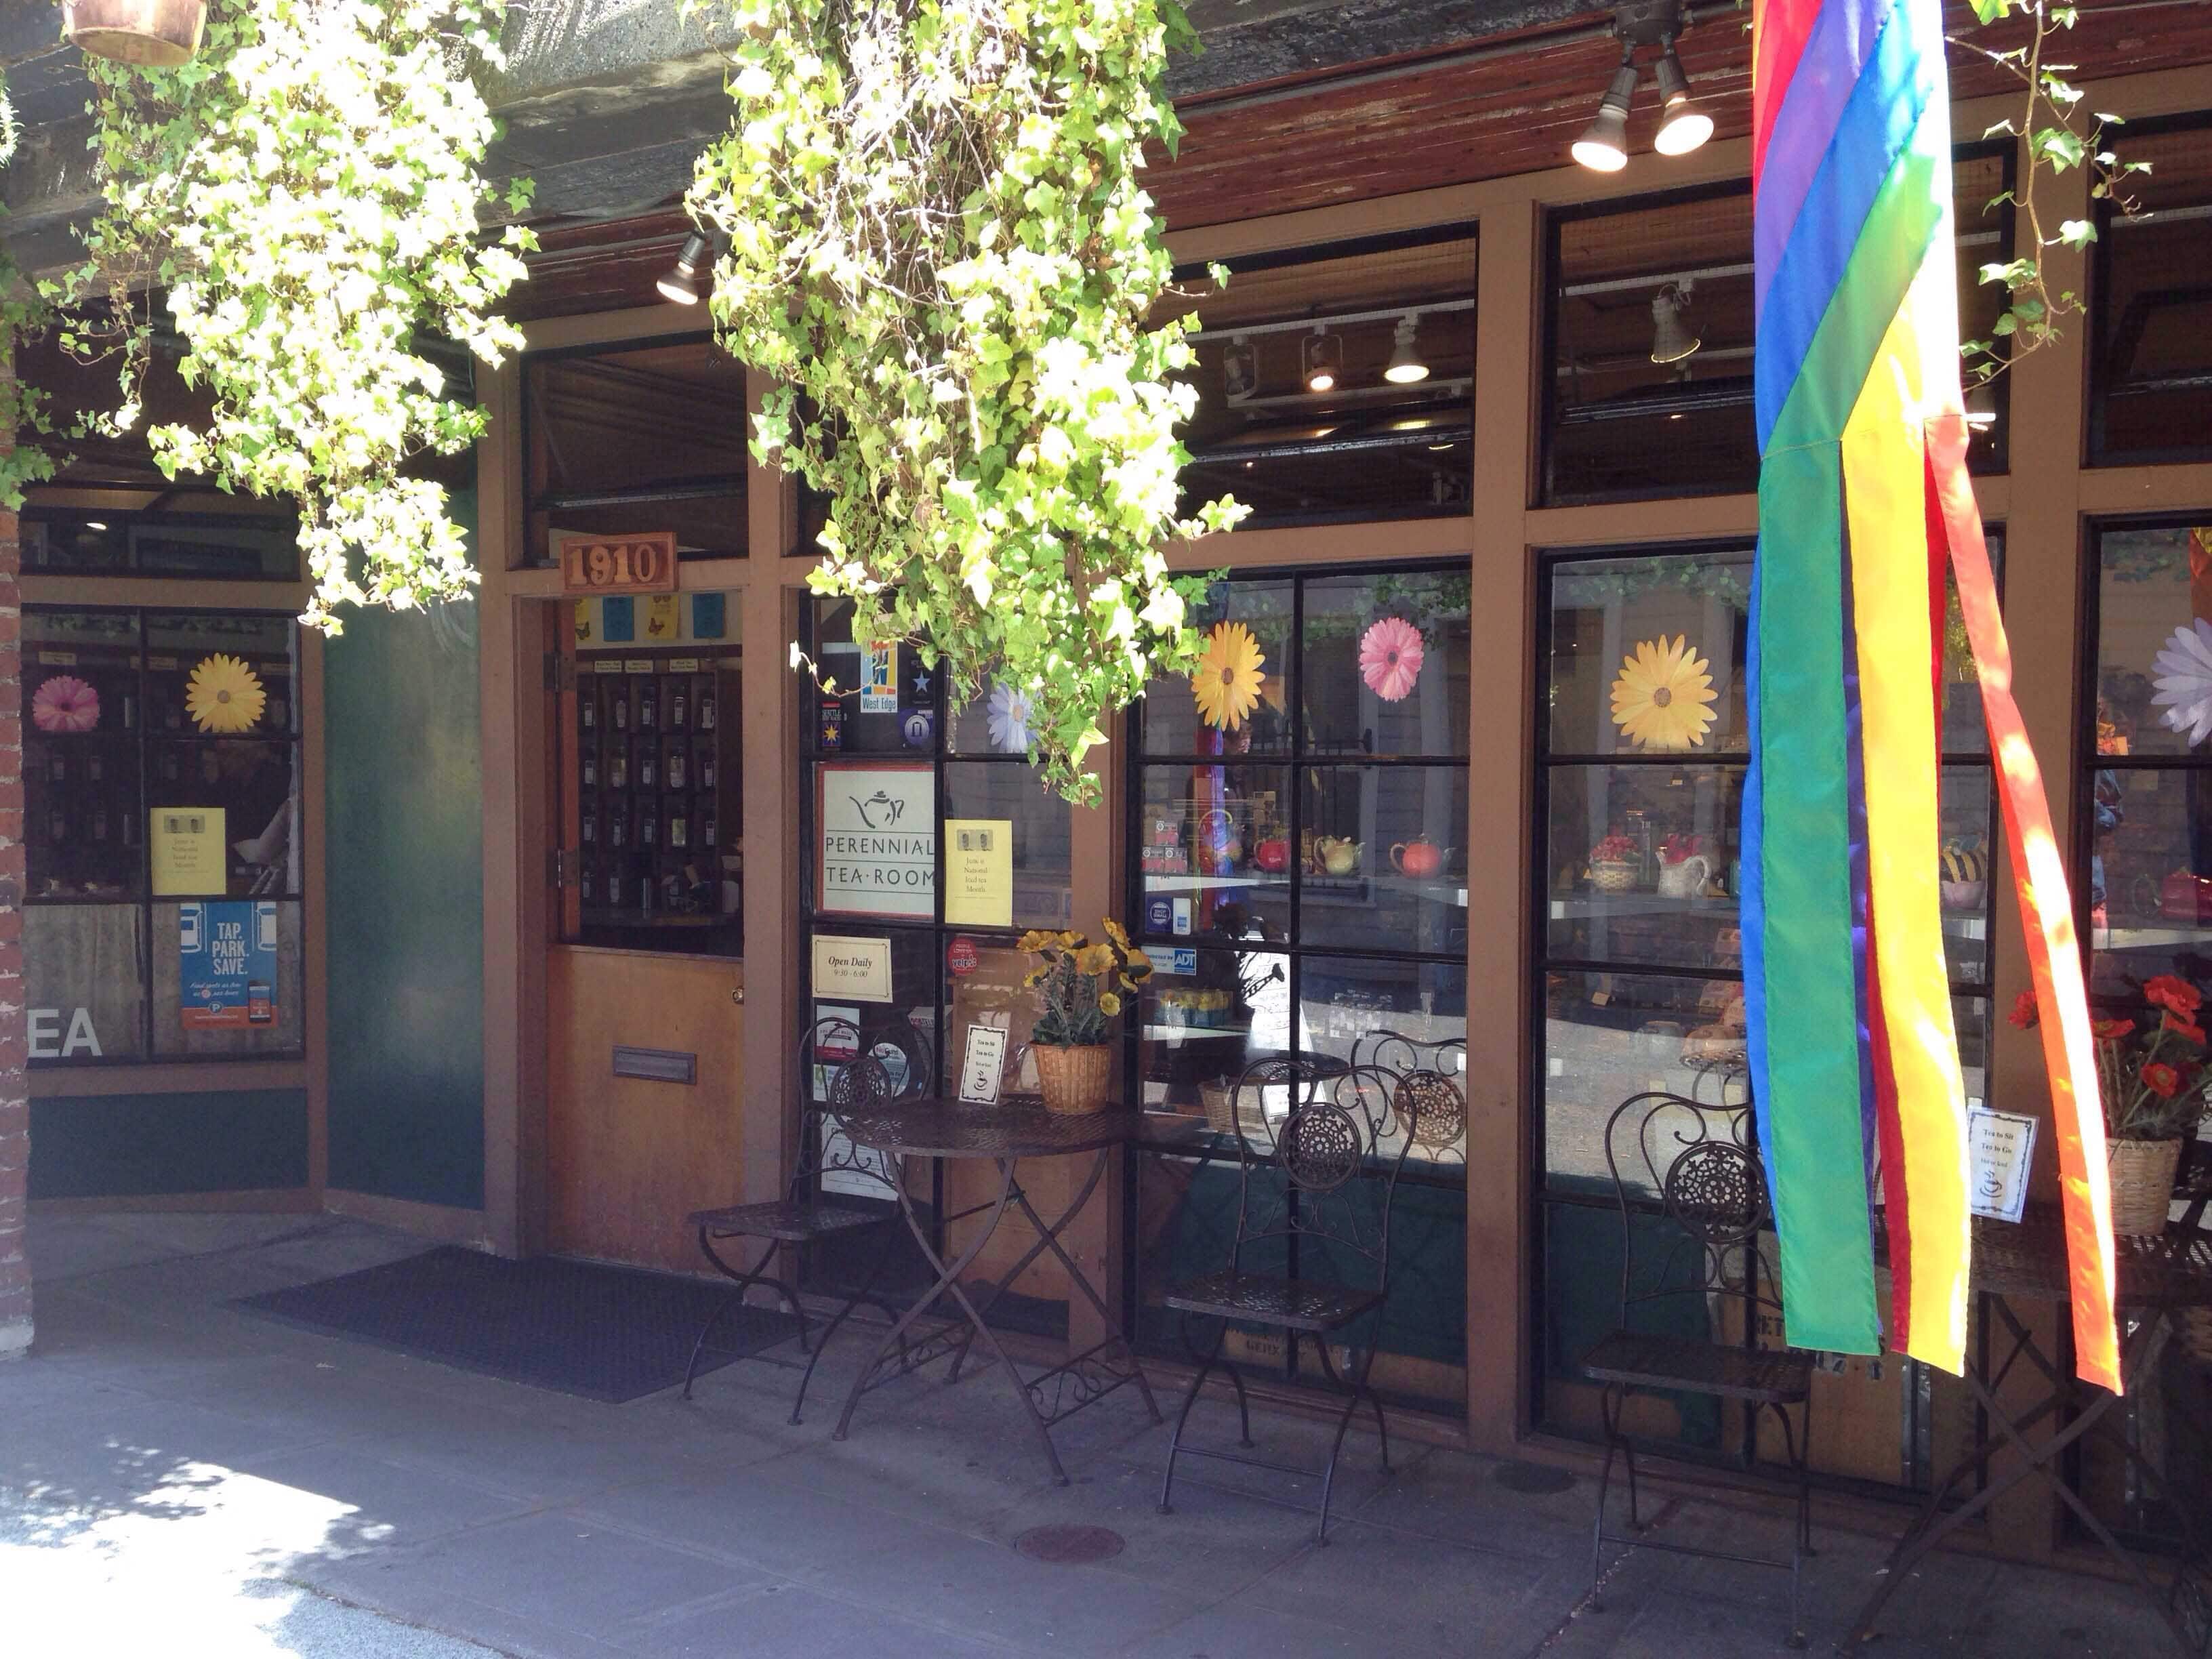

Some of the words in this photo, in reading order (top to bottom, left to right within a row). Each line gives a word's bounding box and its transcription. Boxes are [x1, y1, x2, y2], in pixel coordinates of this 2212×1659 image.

[569, 544, 657, 586] 1910
[862, 697, 879, 710] West
[881, 697, 896, 711] Edge
[825, 836, 935, 855] PERENNIAL
[217, 922, 243, 940] TAP.
[211, 940, 250, 958] PARK.
[213, 958, 248, 975] SAVE.
[828, 956, 848, 967] Open
[851, 957, 872, 969] Daily
[1175, 954, 1194, 966] ADT
[1983, 1128, 1995, 1136] Tea
[2002, 1145, 2012, 1153] Go
